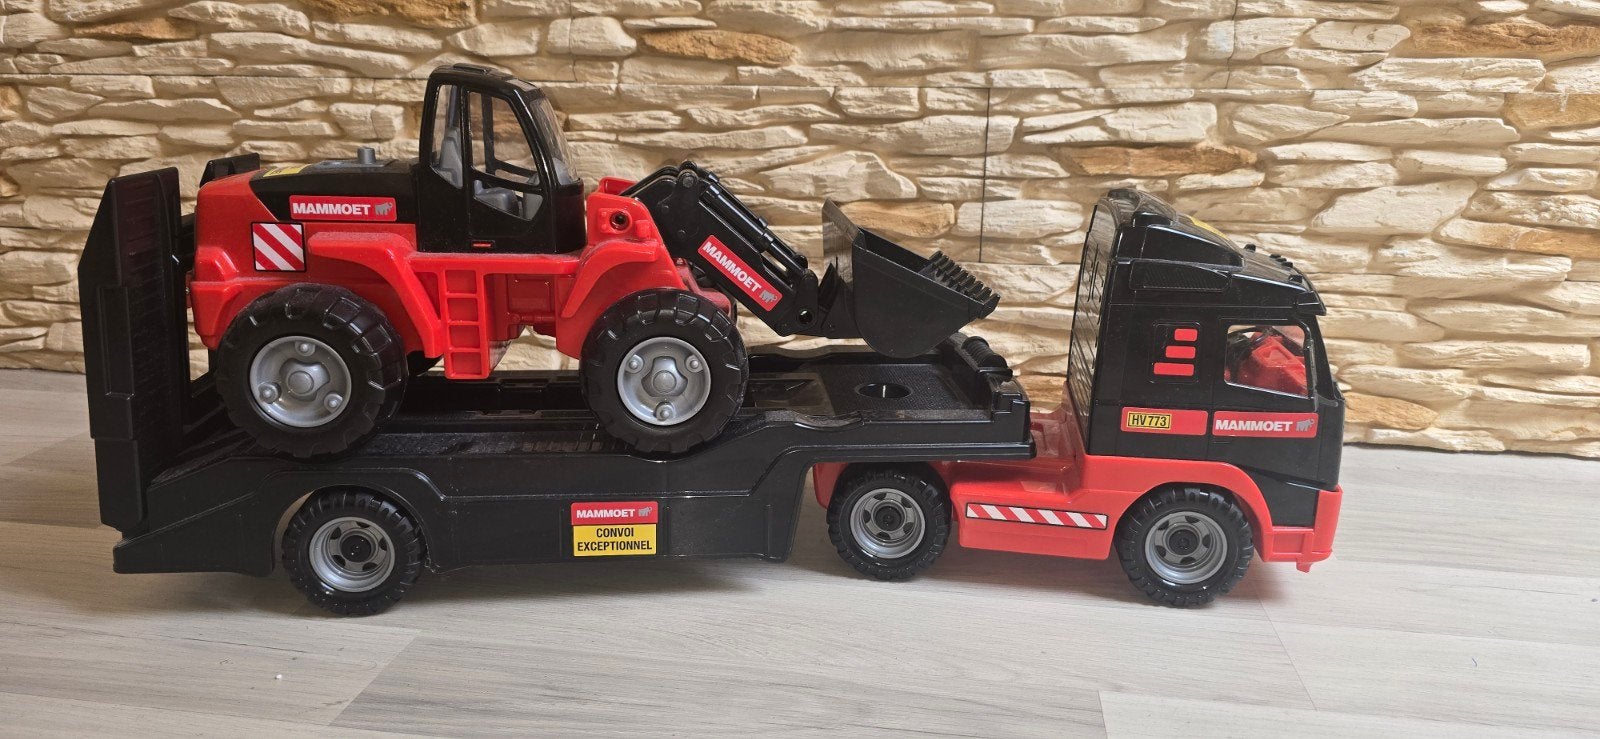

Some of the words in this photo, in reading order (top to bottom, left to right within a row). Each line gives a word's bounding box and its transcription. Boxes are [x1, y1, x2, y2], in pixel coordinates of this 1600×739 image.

[293, 202, 371, 216] MAMMOET
[702, 241, 762, 292] MAMMOET
[1132, 414, 1147, 426] HV
[1148, 415, 1167, 427] 773
[1215, 419, 1293, 432] MAMMOET
[576, 508, 636, 519] MAMMOET
[596, 527, 634, 538] CONVOI
[577, 540, 652, 552] EXCEPTIONNEL
